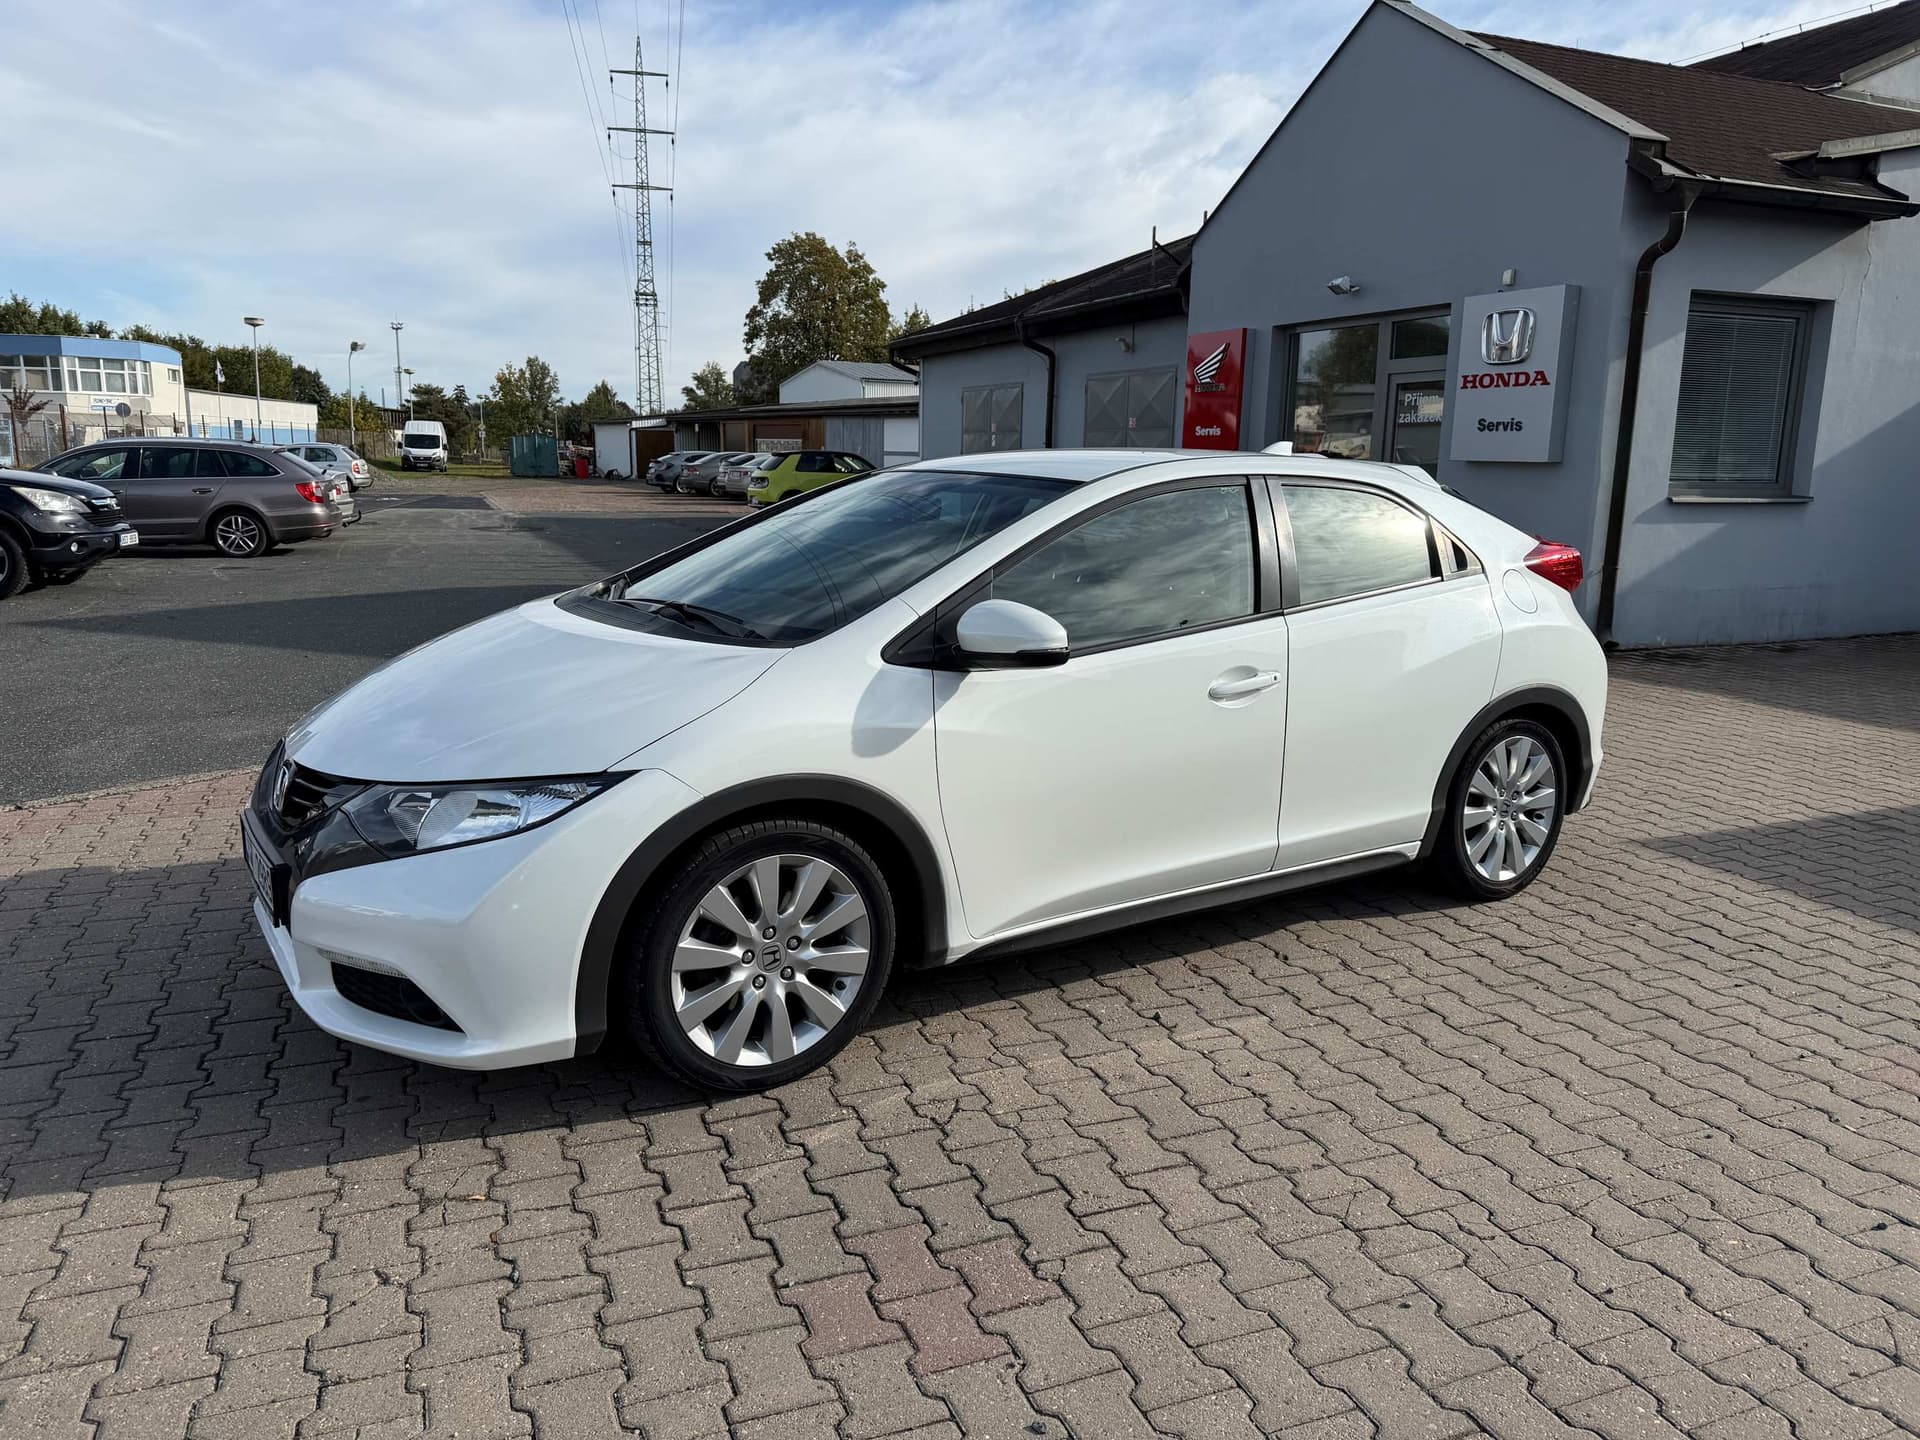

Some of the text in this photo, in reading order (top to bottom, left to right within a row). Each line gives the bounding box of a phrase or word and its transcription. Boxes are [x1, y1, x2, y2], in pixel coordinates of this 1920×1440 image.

[1460, 370, 1551, 390] HONDA
[1195, 425, 1222, 437] Servis
[1477, 417, 1524, 433] Servis
